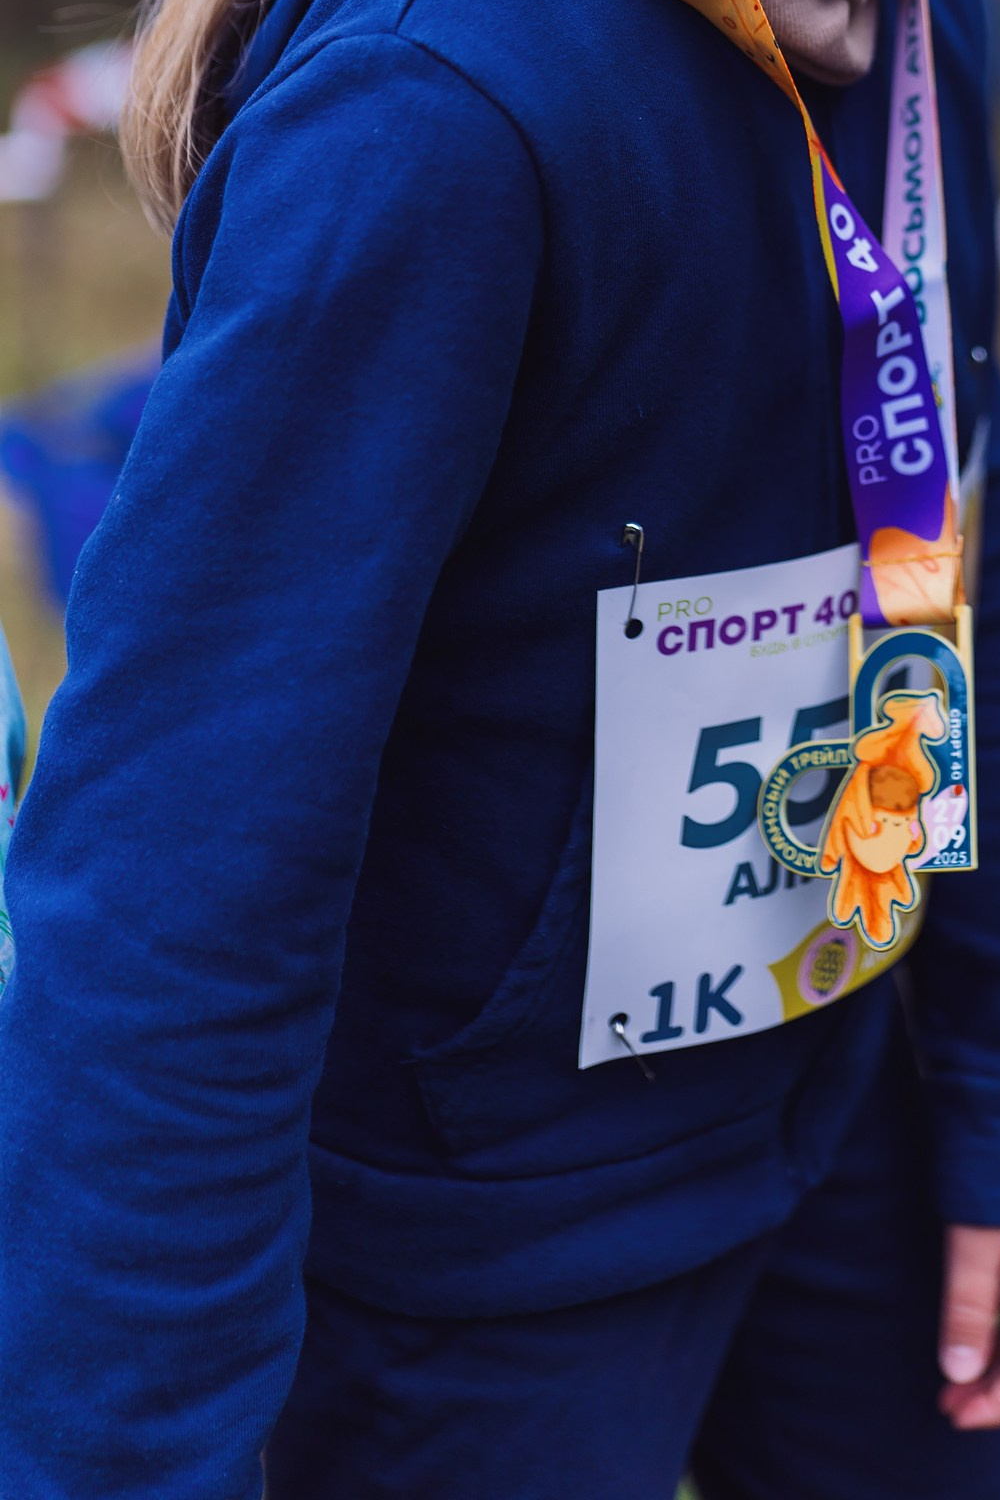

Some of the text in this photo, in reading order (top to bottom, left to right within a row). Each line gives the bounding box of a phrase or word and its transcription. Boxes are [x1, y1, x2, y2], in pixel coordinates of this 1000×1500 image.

[829, 203, 934, 477] СПОРТ 40
[853, 414, 888, 486] PRO
[656, 595, 714, 622] PRO
[656, 589, 859, 657] СПОРТ 40
[949, 707, 963, 781] СПОРТ 40
[762, 746, 849, 869] АТОМНЫЙ ТРЕЙЛ
[932, 798, 962, 824] 27
[932, 823, 966, 850] 09
[932, 851, 968, 866] 2025
